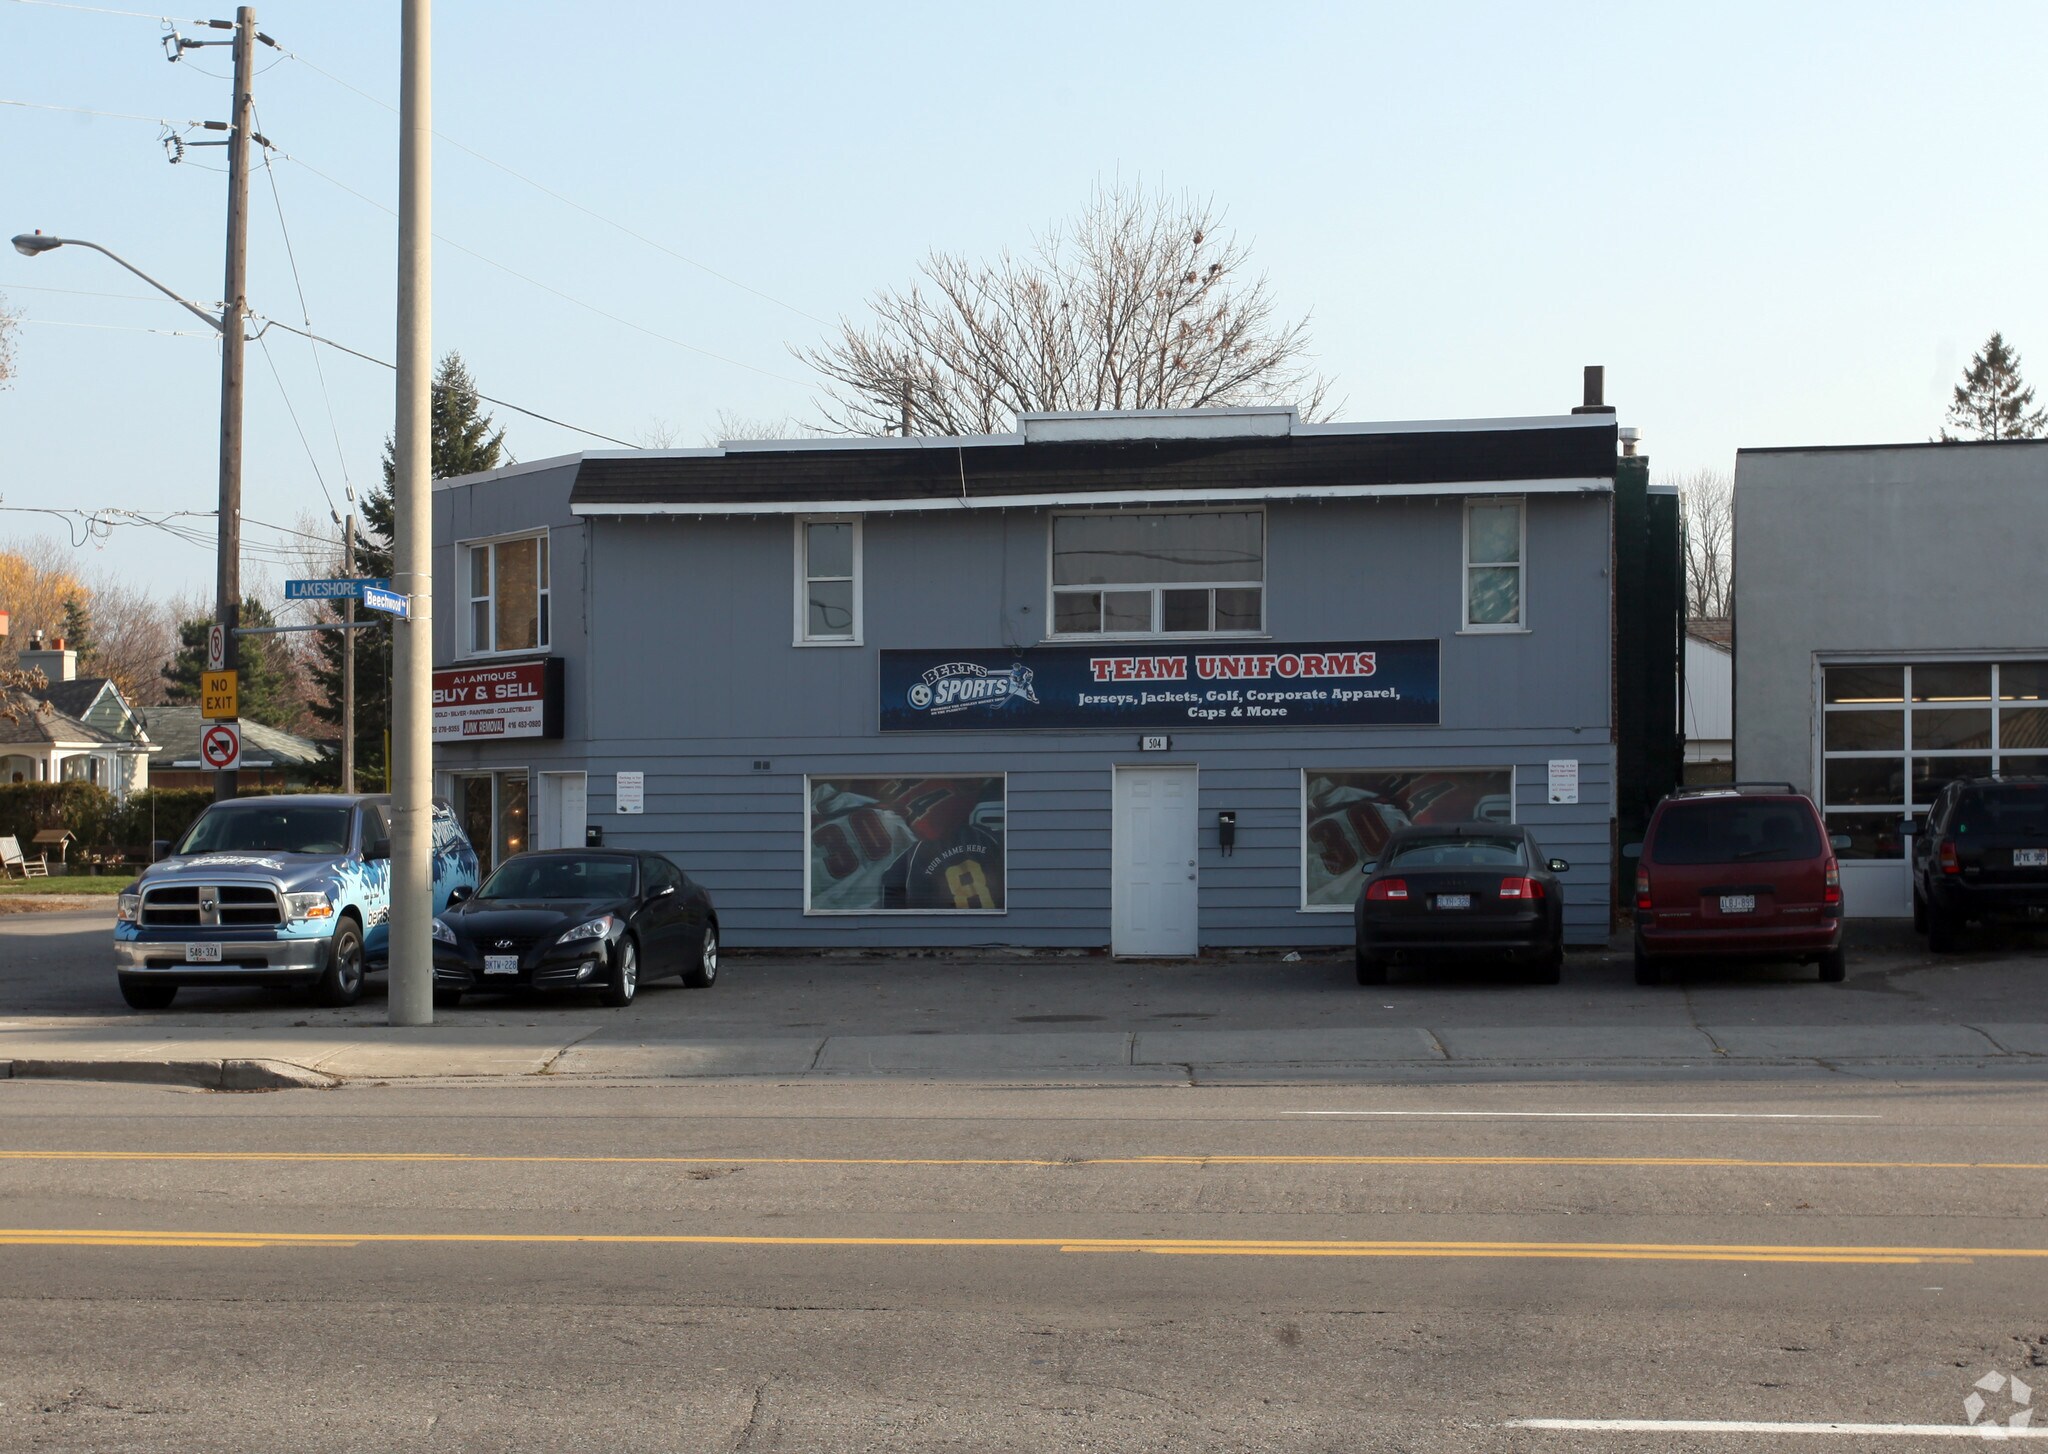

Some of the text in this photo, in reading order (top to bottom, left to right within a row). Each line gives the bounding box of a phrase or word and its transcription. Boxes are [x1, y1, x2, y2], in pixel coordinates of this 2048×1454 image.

[292, 582, 357, 596] LAKESHORE
[367, 591, 401, 612] Beechwood
[922, 662, 988, 686] BERT'S
[1090, 652, 1376, 682] TEAM UNIFORMS
[468, 671, 517, 683] ANTIQUES
[211, 679, 227, 691] NO
[935, 679, 1009, 704] SPORTS
[432, 682, 538, 703] BUY & SELL
[1079, 687, 1400, 706] Jerseys, Jackets, Golf, Corporate Apparel,
[206, 696, 232, 710] EXIT
[469, 708, 495, 716] PAINTINGS
[1187, 706, 1288, 720] Caps & More
[464, 719, 504, 733] JUNK REMOVAL
[1149, 738, 1161, 748] 504
[925, 844, 987, 876] YOUR NAME HERE
